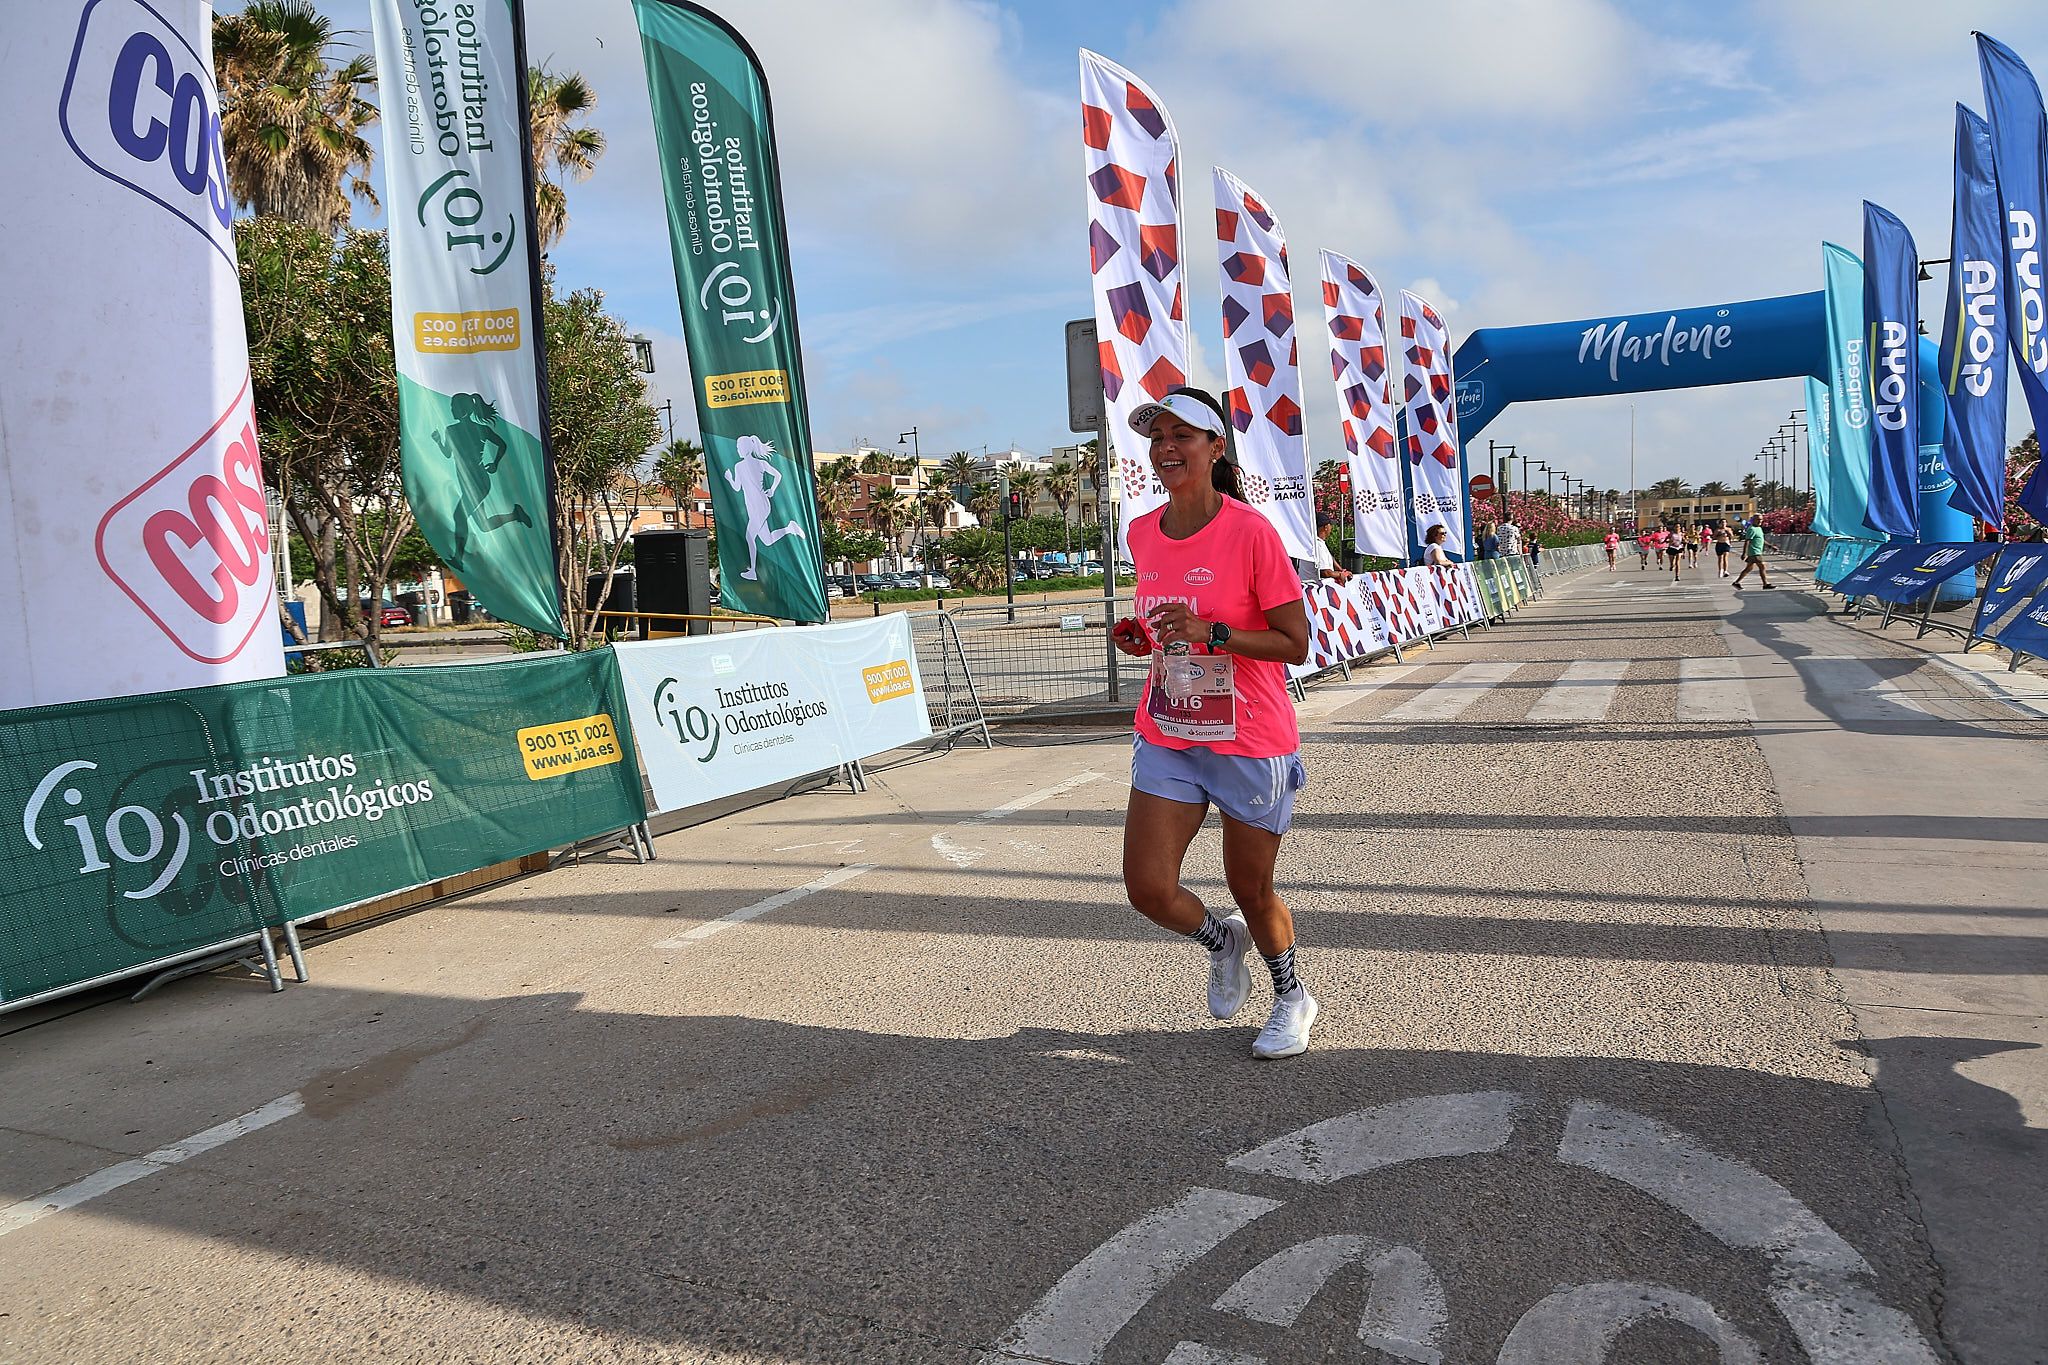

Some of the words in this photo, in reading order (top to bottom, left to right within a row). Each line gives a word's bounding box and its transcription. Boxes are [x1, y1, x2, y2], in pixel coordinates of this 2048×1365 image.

[108, 31, 234, 238] COS
[1577, 315, 1732, 382] Marlene
[143, 405, 272, 624] COS
[715, 680, 789, 709] Institutos
[725, 698, 827, 737] Odontológicos
[525, 733, 557, 752] 900
[558, 729, 581, 746] 131
[584, 723, 610, 740] 002
[531, 742, 615, 770] www.ioa.es
[189, 751, 357, 805] Institutos
[204, 776, 434, 848] Odontológicos
[219, 849, 289, 878] Clínicas
[288, 834, 359, 861] dentales
